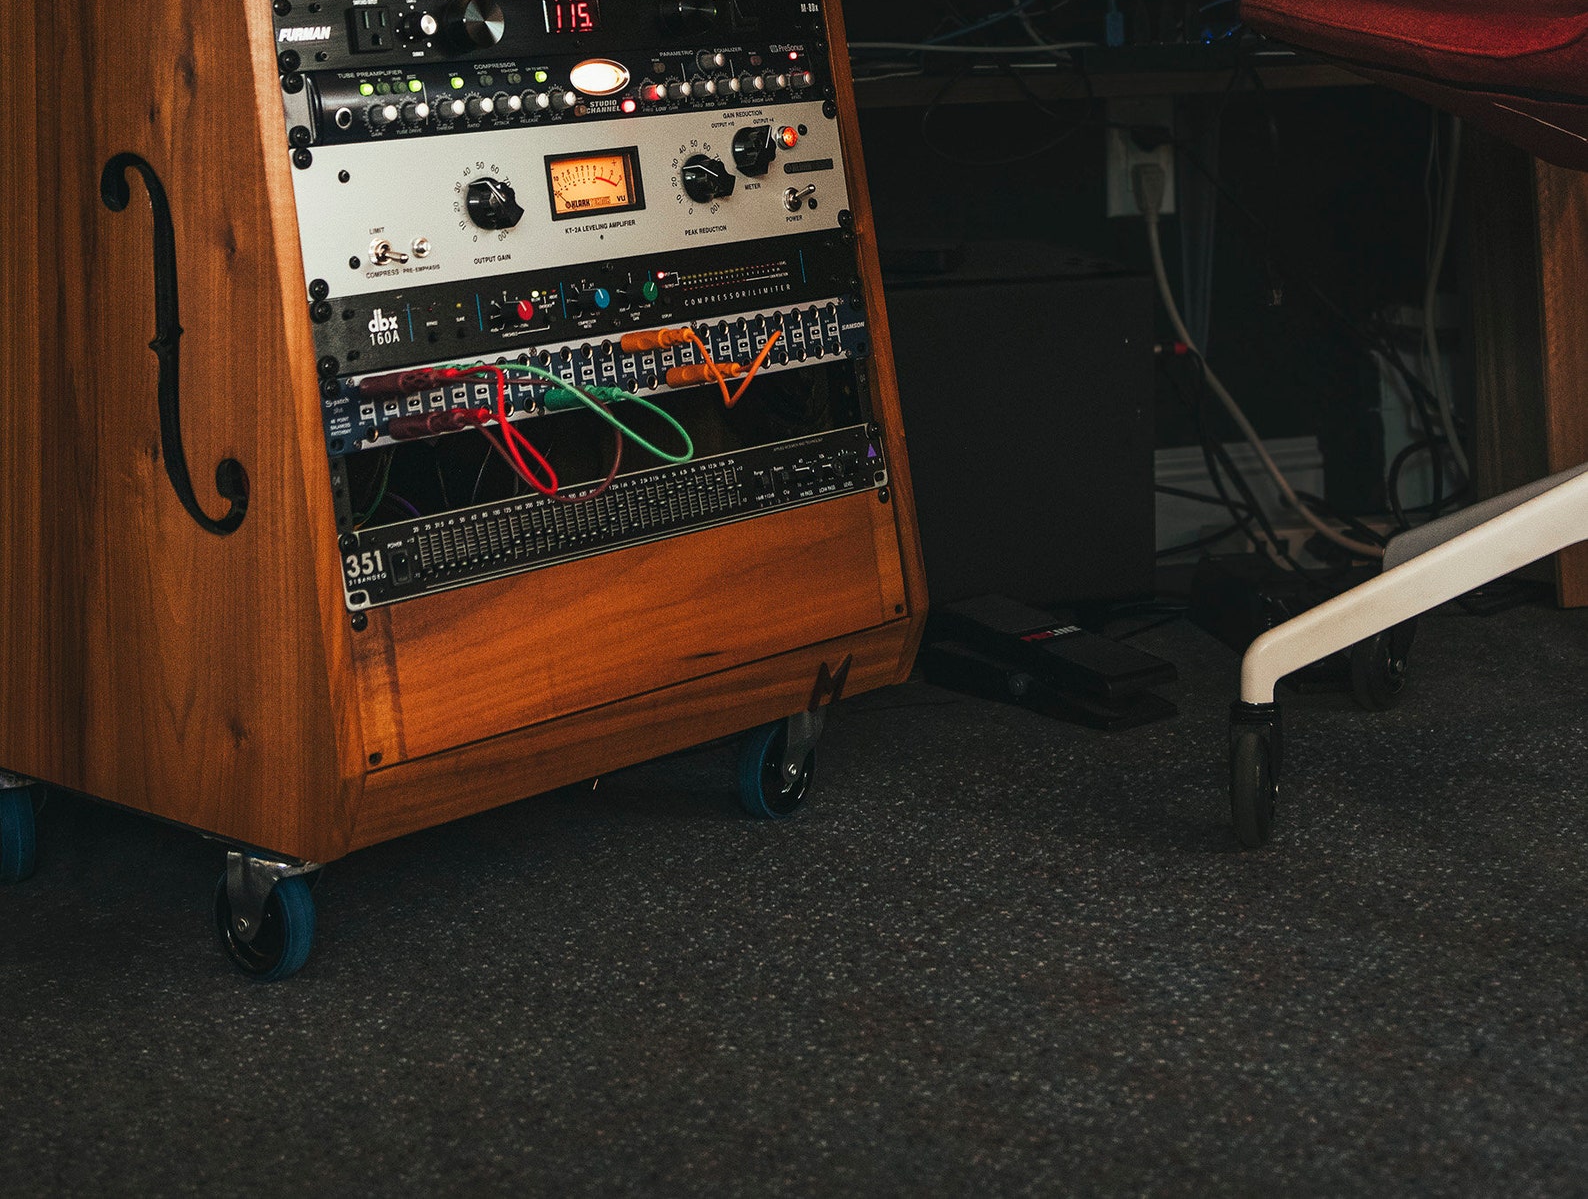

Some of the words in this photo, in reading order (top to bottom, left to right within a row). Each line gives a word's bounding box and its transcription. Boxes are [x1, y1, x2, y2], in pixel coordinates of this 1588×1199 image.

[278, 26, 331, 42] FURMAN
[659, 50, 694, 58] PARAMETRIC
[714, 46, 742, 54] EQUALIZER
[474, 62, 517, 70] COMPRESSOR
[356, 69, 403, 78] PREAMPLIFIER
[586, 106, 621, 114] CHANNEL
[736, 110, 763, 118] REDUCTION
[690, 139, 698, 148] 50
[703, 142, 711, 151] 60
[679, 145, 687, 154] 40
[476, 162, 485, 170] 50
[671, 158, 679, 169] 30
[463, 167, 471, 177] 40
[490, 164, 500, 174] 60
[503, 176, 512, 187] 70
[671, 177, 678, 187] 20
[454, 181, 462, 193] 30
[453, 201, 460, 213] 20
[710, 203, 720, 214] 100
[786, 215, 803, 223] POWER
[459, 220, 466, 231] 10
[565, 226, 582, 234] KT-2A
[582, 223, 608, 232] LEVELING
[609, 220, 636, 229] AMPLIFIER
[699, 225, 727, 234] REDUCTION
[369, 227, 385, 235] LIMIT
[498, 229, 509, 242] 100
[473, 235, 478, 243] 0
[474, 256, 496, 264] OUTPUT
[497, 254, 511, 262] GAIN
[366, 269, 399, 279] COMPRESS
[403, 264, 440, 273] PRE-EMPHASIS
[684, 283, 791, 306] COMPRESSOR/LIMITER
[368, 308, 398, 332] dbx
[841, 321, 865, 331] SAMSON
[369, 330, 400, 346] 160A
[346, 550, 383, 578] 351
